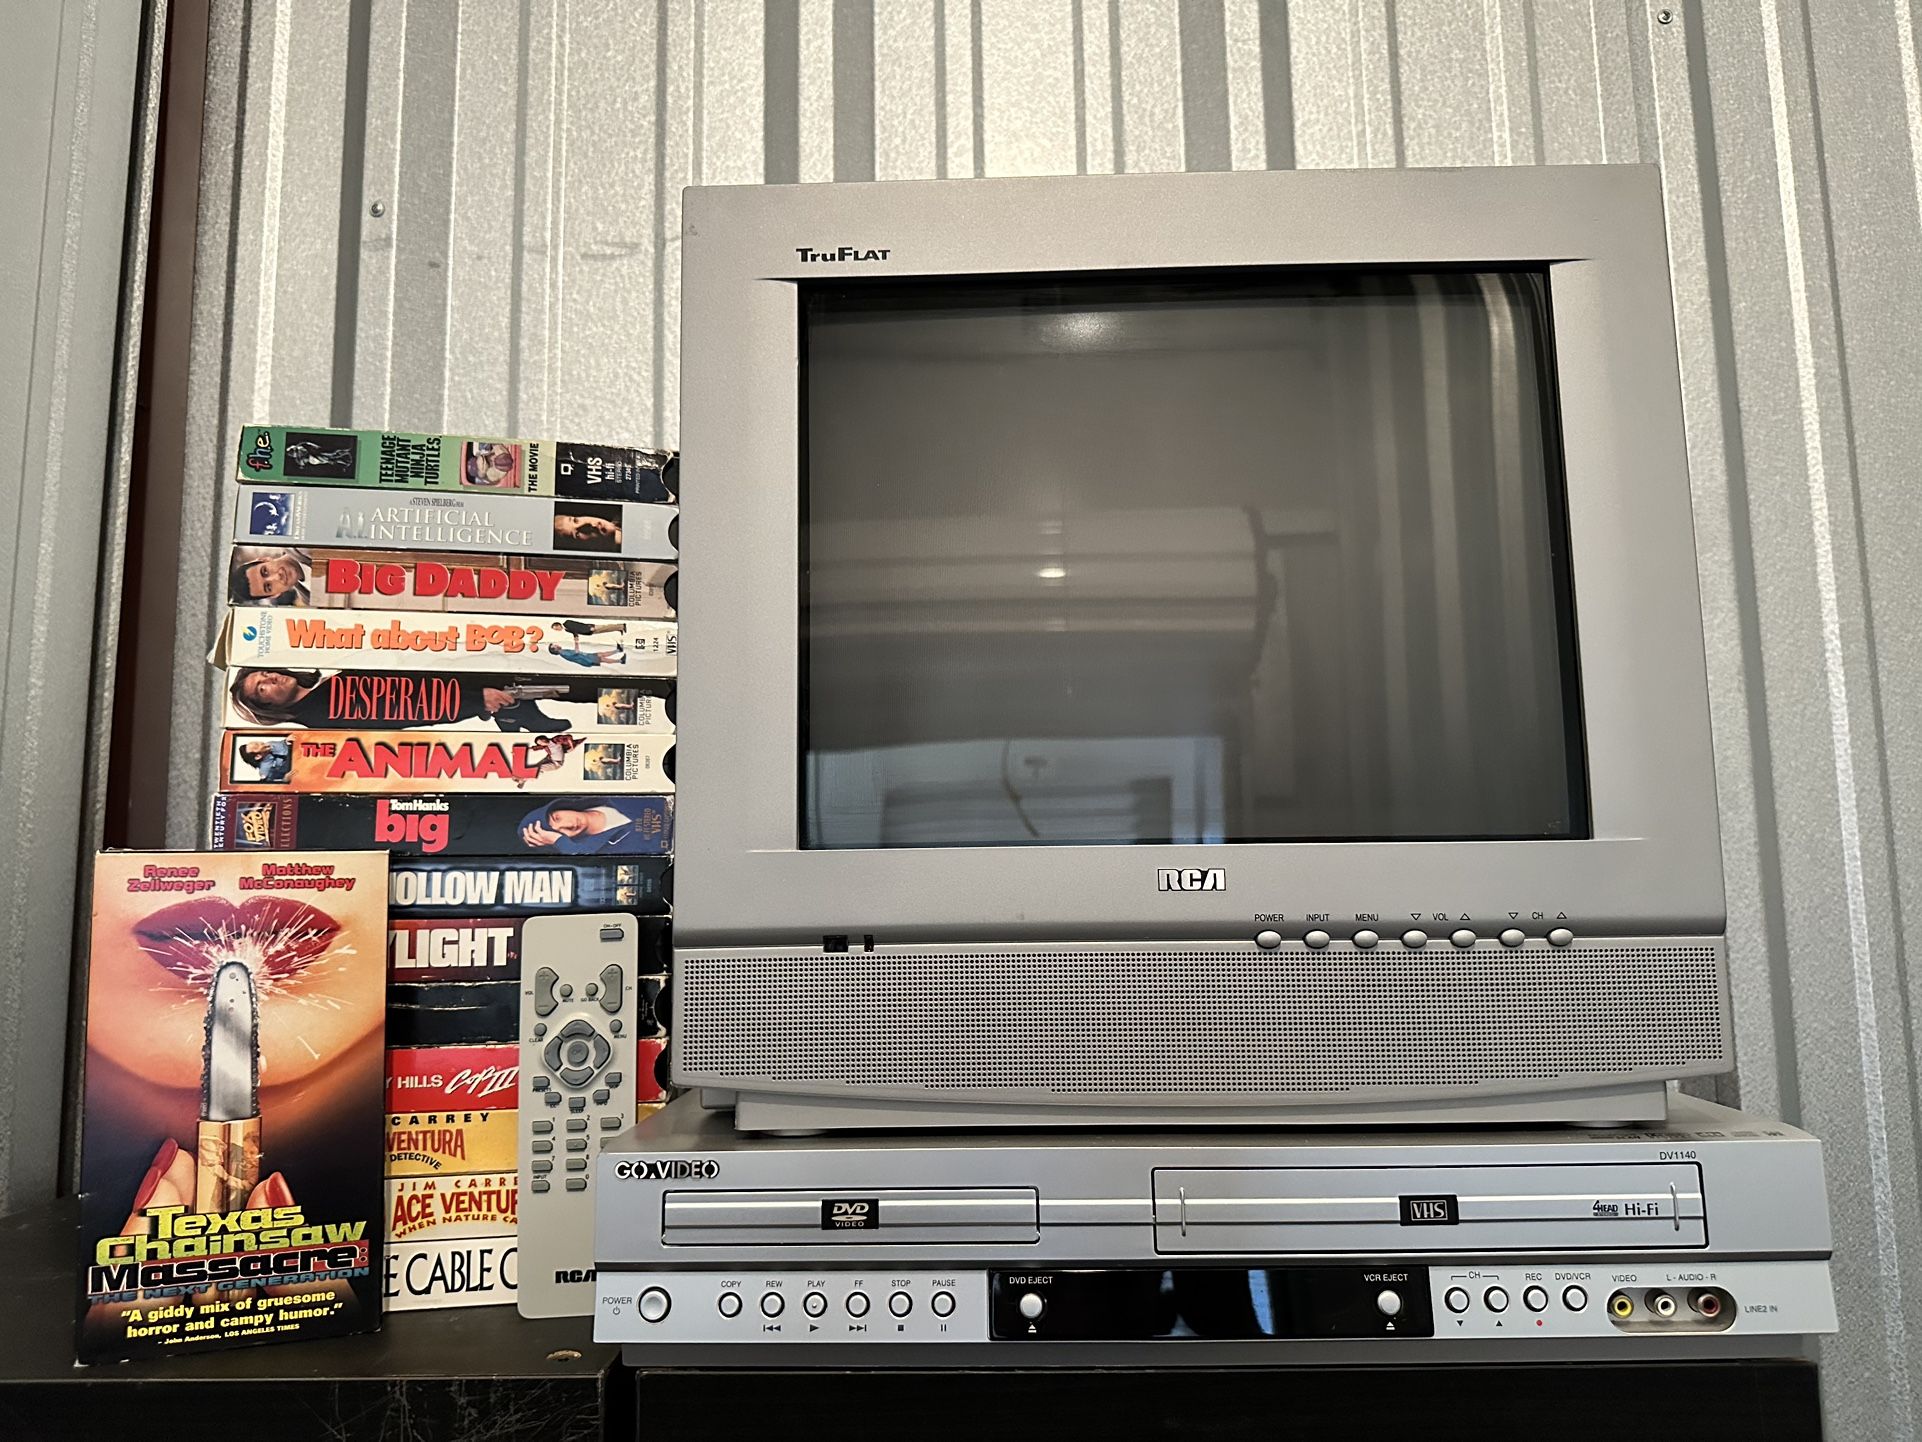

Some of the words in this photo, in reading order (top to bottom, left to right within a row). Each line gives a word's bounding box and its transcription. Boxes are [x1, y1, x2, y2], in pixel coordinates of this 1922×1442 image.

[379, 435, 396, 483] TEENAGE
[394, 437, 411, 483] MUTANT
[410, 444, 425, 478] NINJA
[530, 443, 539, 472] MOVIE
[587, 457, 602, 484] VHS
[528, 477, 537, 493] THE
[413, 497, 430, 506] STEVEN
[370, 507, 496, 527] ARTIFICIAL
[370, 524, 533, 546] INTELLIGENCE
[326, 559, 406, 596] BIG
[414, 562, 566, 601] DADDY
[258, 611, 267, 658] TOUCHSTONE
[285, 618, 365, 650] What
[371, 620, 459, 652] about
[666, 634, 677, 655] VHS
[328, 675, 461, 721] DESPERADO
[301, 742, 336, 757] THE
[326, 737, 540, 779] ANIMAL
[390, 799, 413, 811] Tom
[413, 799, 450, 811] Hanks
[240, 812, 256, 840] FOX
[255, 811, 265, 842] VIDEO
[281, 798, 292, 848] ELECTIONS
[375, 800, 449, 853] big
[143, 864, 200, 878] Renee
[262, 863, 335, 876] Matthew
[127, 878, 215, 894] Zellweger
[239, 876, 356, 891] McConaughey
[503, 870, 573, 904] MAN
[1158, 868, 1226, 892] RCA
[1254, 914, 1284, 922] POWER
[1306, 914, 1330, 922] INPUT
[1355, 914, 1379, 922] MENU
[1432, 913, 1449, 921] VOL
[1531, 912, 1544, 920] CH
[389, 927, 514, 969] LIGHT
[397, 1075, 443, 1089] HILLS
[391, 1112, 490, 1126] CARREY
[386, 1129, 465, 1160] VENTURA
[390, 1151, 442, 1170] DETECTIVE
[1659, 1150, 1697, 1160] DV1140
[398, 1180, 436, 1191] JIM
[454, 1176, 518, 1189] CARRE
[391, 1193, 434, 1231] ACE
[832, 1202, 869, 1214] DVD
[1412, 1201, 1446, 1219] VHS
[1624, 1202, 1659, 1215] Hi-Fi
[146, 1205, 305, 1239] Texas
[395, 1218, 437, 1239] WHEN
[442, 1213, 497, 1224] NATURE
[96, 1220, 367, 1266] Chainsaw
[405, 1248, 494, 1296] CABLE
[555, 1269, 597, 1283] RCA
[1363, 1273, 1381, 1282] VCR
[1383, 1273, 1408, 1282] EJECT
[1468, 1271, 1481, 1279] CH
[1525, 1272, 1542, 1281] REC
[1555, 1271, 1591, 1281] DVD/VCR
[1611, 1274, 1637, 1283] VIDEO
[1666, 1273, 1670, 1281] L
[1678, 1273, 1705, 1281] AUDIO
[1711, 1273, 1717, 1281] R
[88, 1291, 139, 1304] THE
[143, 1283, 210, 1300] NEXT
[217, 1267, 370, 1291] GENERATION
[720, 1280, 741, 1289] COPY
[765, 1280, 783, 1288] REW
[807, 1280, 825, 1288] PLAY
[854, 1280, 864, 1288] FF
[891, 1279, 911, 1288] STOP
[932, 1279, 956, 1287] PAUSE
[1009, 1276, 1026, 1285] DVD
[1028, 1276, 1054, 1285] EJECT
[148, 1304, 194, 1323] giddy
[200, 1300, 230, 1314] mix
[235, 1298, 253, 1311] of
[257, 1291, 336, 1310] gruesome
[602, 1296, 633, 1305] POWER
[1744, 1304, 1767, 1313] LINE2
[1769, 1304, 1778, 1313] IN
[126, 1324, 180, 1339] horror
[184, 1318, 214, 1333] and
[220, 1313, 274, 1330] campy
[164, 1337, 182, 1345] John
[224, 1330, 239, 1338] LOS
[241, 1326, 275, 1336] ANGELES
[276, 1323, 300, 1332] TIMES
